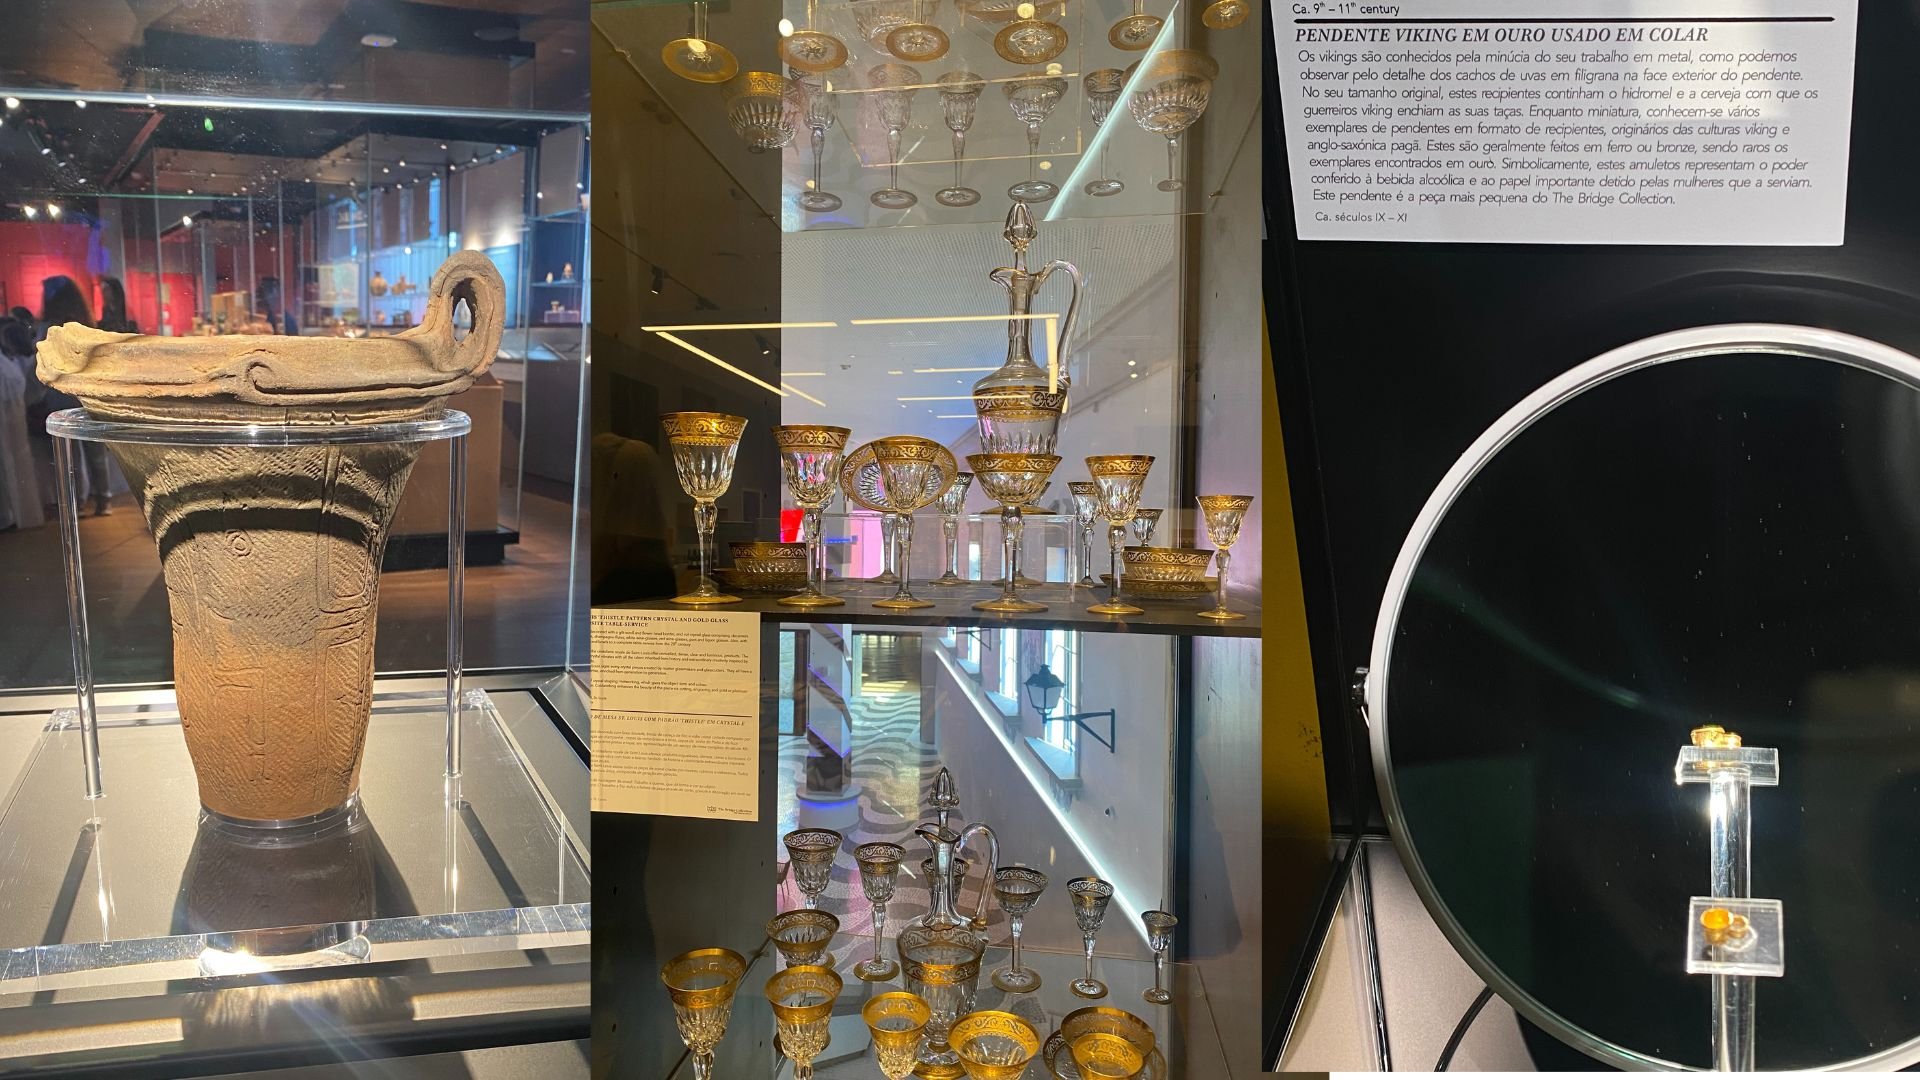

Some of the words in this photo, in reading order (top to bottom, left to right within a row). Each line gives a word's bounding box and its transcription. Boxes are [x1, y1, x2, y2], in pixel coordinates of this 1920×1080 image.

[1292, 2, 1311, 15] Ca.
[1359, 4, 1400, 17] century
[1295, 27, 1391, 43] PENDENTE
[1395, 27, 1458, 43] VIKING
[1461, 27, 1491, 43] EM
[1494, 27, 1546, 43] OURO
[1551, 27, 1611, 43] USADO
[1615, 27, 1645, 42] EM
[1648, 27, 1709, 42] COLAR
[1297, 49, 1316, 63] Os
[1318, 48, 1358, 67] vikings
[1361, 50, 1382, 63] são
[1385, 49, 1452, 63] conhecidos
[1455, 49, 1481, 68] pela
[1485, 49, 1530, 63] minúcia
[1534, 49, 1552, 63] do
[1555, 53, 1577, 63] seu
[1580, 49, 1629, 63] trabalho
[1633, 53, 1653, 63] em
[1657, 49, 1694, 65] metal,
[1698, 53, 1734, 63] como
[1737, 48, 1797, 67] podemos
[1299, 66, 1350, 85] observar
[1352, 67, 1379, 86] pelo
[1382, 66, 1426, 81] detalhe
[1429, 67, 1452, 81] dos
[1455, 67, 1496, 82] cachos
[1499, 67, 1516, 82] de
[1520, 71, 1547, 82] uvas
[1550, 71, 1570, 82] em
[1574, 67, 1620, 85] filigrana
[1623, 71, 1639, 82] na
[1643, 67, 1668, 82] face
[1671, 68, 1718, 81] exterior
[1720, 67, 1738, 81] do
[1741, 67, 1803, 85] pendente.
[1302, 84, 1321, 99] No
[1323, 88, 1344, 99] seu
[1347, 84, 1398, 99] tamanho
[1401, 84, 1444, 103] original,
[1448, 88, 1478, 99] estes
[1481, 86, 1541, 104] recipientes
[1544, 85, 1605, 100] continham
[1608, 90, 1618, 100] o
[1621, 85, 1673, 100] hidromel
[1676, 90, 1685, 100] e
[1688, 90, 1697, 100] a
[1700, 86, 1741, 103] cerveja
[1745, 89, 1772, 100] com
[1775, 89, 1801, 103] que
[1804, 89, 1818, 99] os
[1303, 103, 1358, 120] guerreiros
[1360, 102, 1393, 120] viking
[1397, 103, 1444, 117] enchiam
[1447, 107, 1461, 117] as
[1464, 107, 1490, 117] suas
[1493, 105, 1524, 121] taças.
[1529, 104, 1584, 122] Enquanto
[1587, 104, 1642, 119] miniatura,
[1646, 103, 1724, 118] conhecem-se
[1727, 104, 1761, 118] vários
[1305, 120, 1368, 138] exemplares
[1371, 120, 1388, 134] de
[1390, 120, 1450, 138] pendentes
[1454, 125, 1473, 135] em
[1477, 121, 1522, 135] formato
[1525, 121, 1542, 135] de
[1544, 122, 1607, 139] recipientes,
[1611, 122, 1670, 139] originários
[1672, 121, 1694, 136] das
[1697, 121, 1741, 136] culturas
[1744, 121, 1778, 139] viking
[1781, 126, 1790, 135] e
[1307, 137, 1387, 154] anglo-saxónica
[1390, 139, 1422, 156] pagã.
[1426, 138, 1456, 152] Estes
[1458, 140, 1479, 152] são
[1482, 138, 1546, 156] geralmente
[1550, 138, 1580, 153] feitos
[1583, 143, 1603, 153] em
[1607, 139, 1633, 153] ferro
[1636, 143, 1653, 153] ou
[1656, 139, 1698, 155] bronze,
[1702, 139, 1739, 153] sendo
[1742, 143, 1771, 153] raros
[1774, 143, 1789, 153] os
[1309, 154, 1371, 173] exemplares
[1374, 155, 1443, 169] encontrados
[1445, 159, 1465, 169] em
[1501, 156, 1592, 172] Simbolicamente,
[1596, 159, 1626, 170] estes
[1629, 157, 1681, 171] amuletos
[1684, 160, 1755, 175] representam
[1759, 161, 1768, 171] o
[1771, 158, 1809, 175] poder
[1310, 171, 1362, 185] conferido
[1365, 172, 1373, 185] à
[1376, 172, 1415, 185] bebida
[1418, 172, 1465, 186] alcoólica
[1469, 177, 1478, 186] e
[1480, 177, 1496, 186] ao
[1499, 173, 1532, 191] papel
[1535, 174, 1596, 191] importante
[1598, 174, 1636, 188] detido
[1639, 175, 1670, 192] pelas
[1673, 175, 1725, 188] mulheres
[1728, 178, 1752, 192] que
[1755, 179, 1763, 188] a
[1766, 175, 1812, 188] serviam.
[1313, 188, 1336, 201] Este
[1339, 188, 1393, 205] pendente
[1395, 189, 1404, 202] é
[1407, 193, 1415, 202] a
[1418, 193, 1446, 206] peça
[1449, 191, 1476, 203] mais
[1478, 194, 1528, 207] pequena
[1532, 191, 1548, 204] do
[1552, 191, 1574, 204] The
[1578, 191, 1615, 208] Bridge
[1618, 191, 1676, 205] Collection.
[1314, 211, 1332, 222] Ca.
[1335, 211, 1373, 222] séculos
[1375, 212, 1386, 222] IX
[1396, 212, 1408, 223] XI
